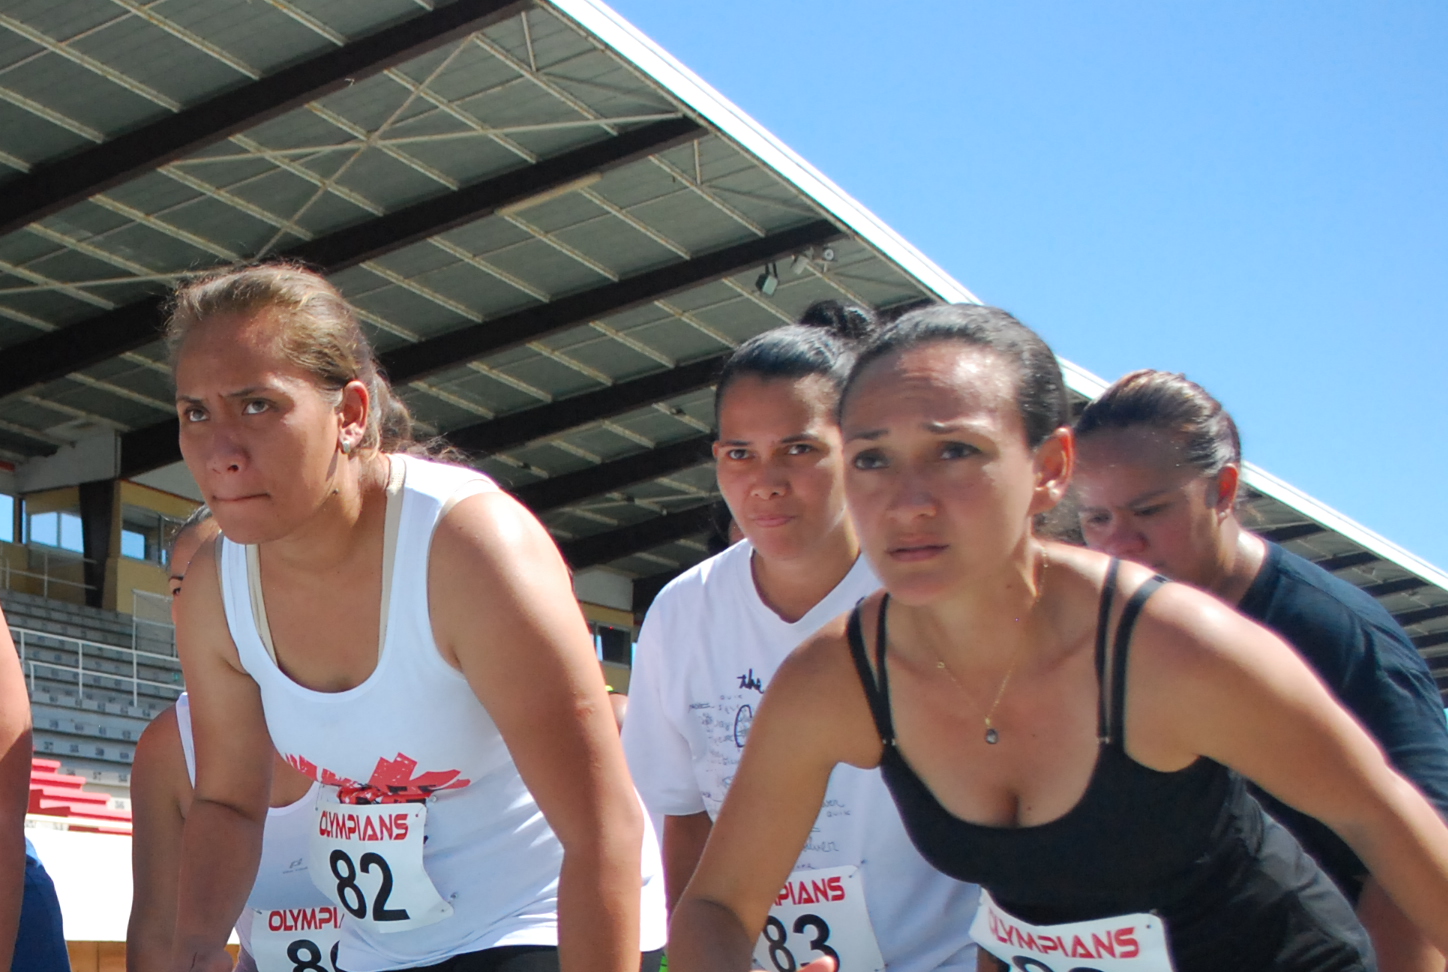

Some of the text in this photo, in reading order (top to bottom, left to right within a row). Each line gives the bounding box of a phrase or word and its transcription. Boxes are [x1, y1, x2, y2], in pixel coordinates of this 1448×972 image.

[319, 810, 409, 842] OLYMPIANS
[329, 849, 411, 922] 82
[775, 876, 845, 906] PIANS
[268, 906, 345, 931] OLYMPI
[988, 906, 1140, 959] OLYMPIANS
